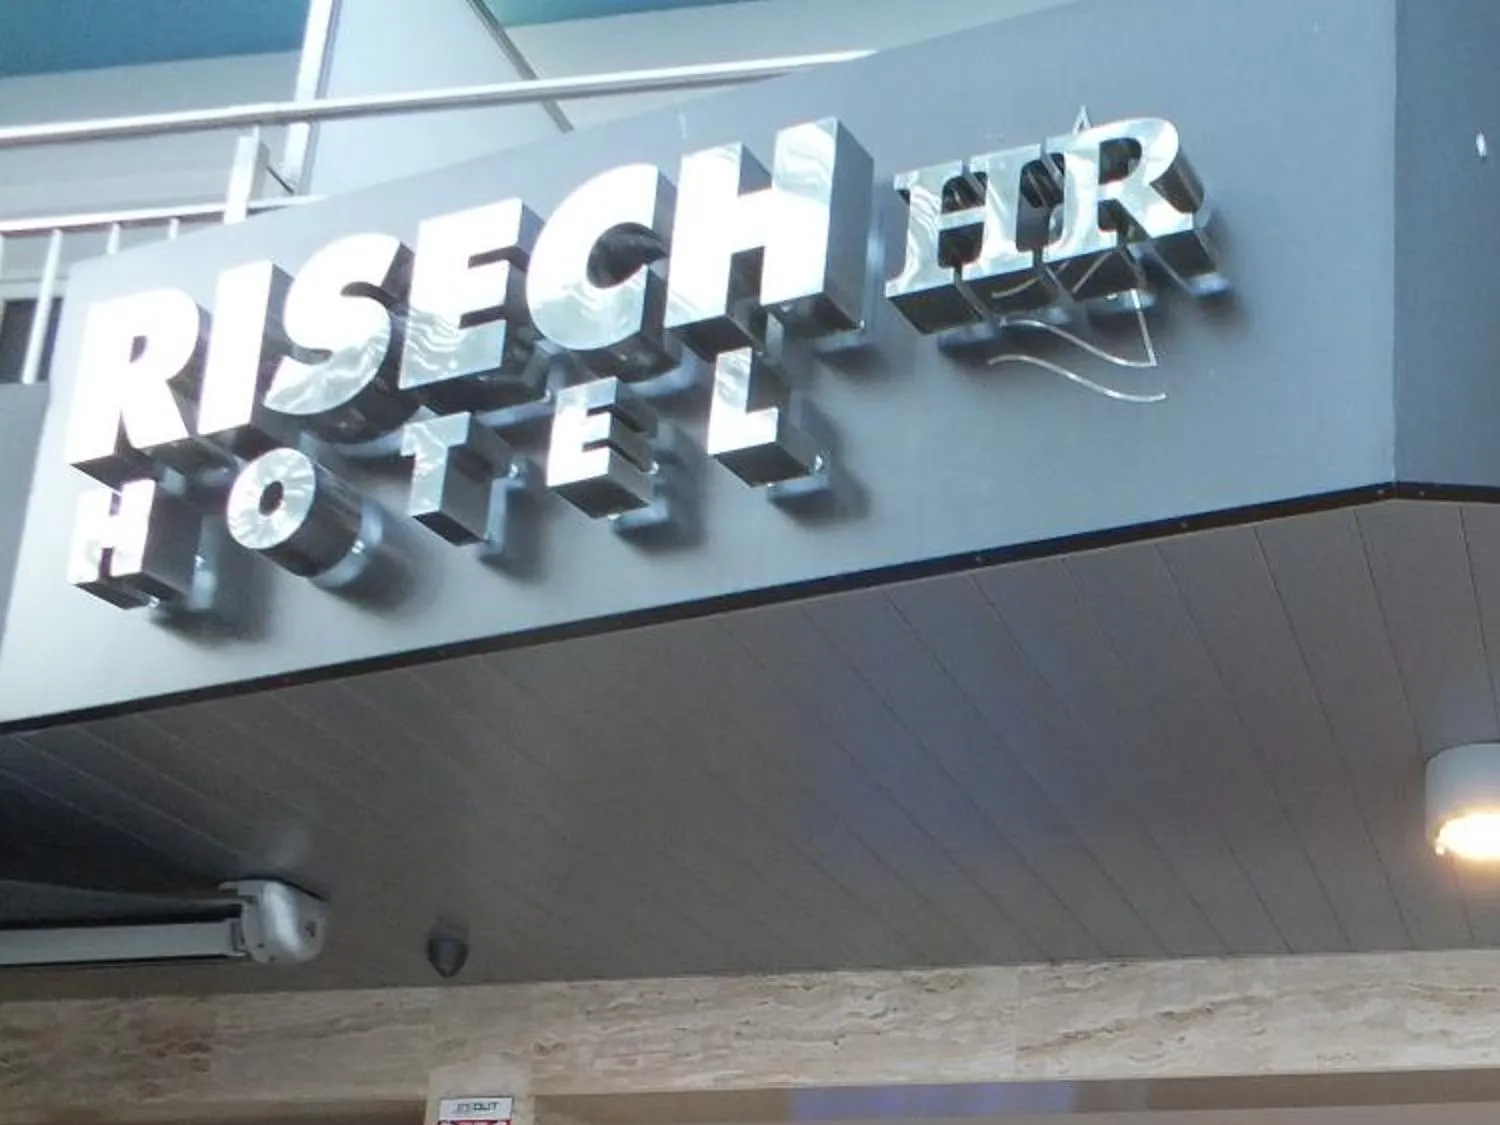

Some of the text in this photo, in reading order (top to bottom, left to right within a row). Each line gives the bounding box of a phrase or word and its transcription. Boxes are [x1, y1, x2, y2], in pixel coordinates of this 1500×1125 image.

[70, 117, 872, 484] RISECH
[887, 117, 1210, 335] HR
[68, 348, 825, 609] HOTEL
